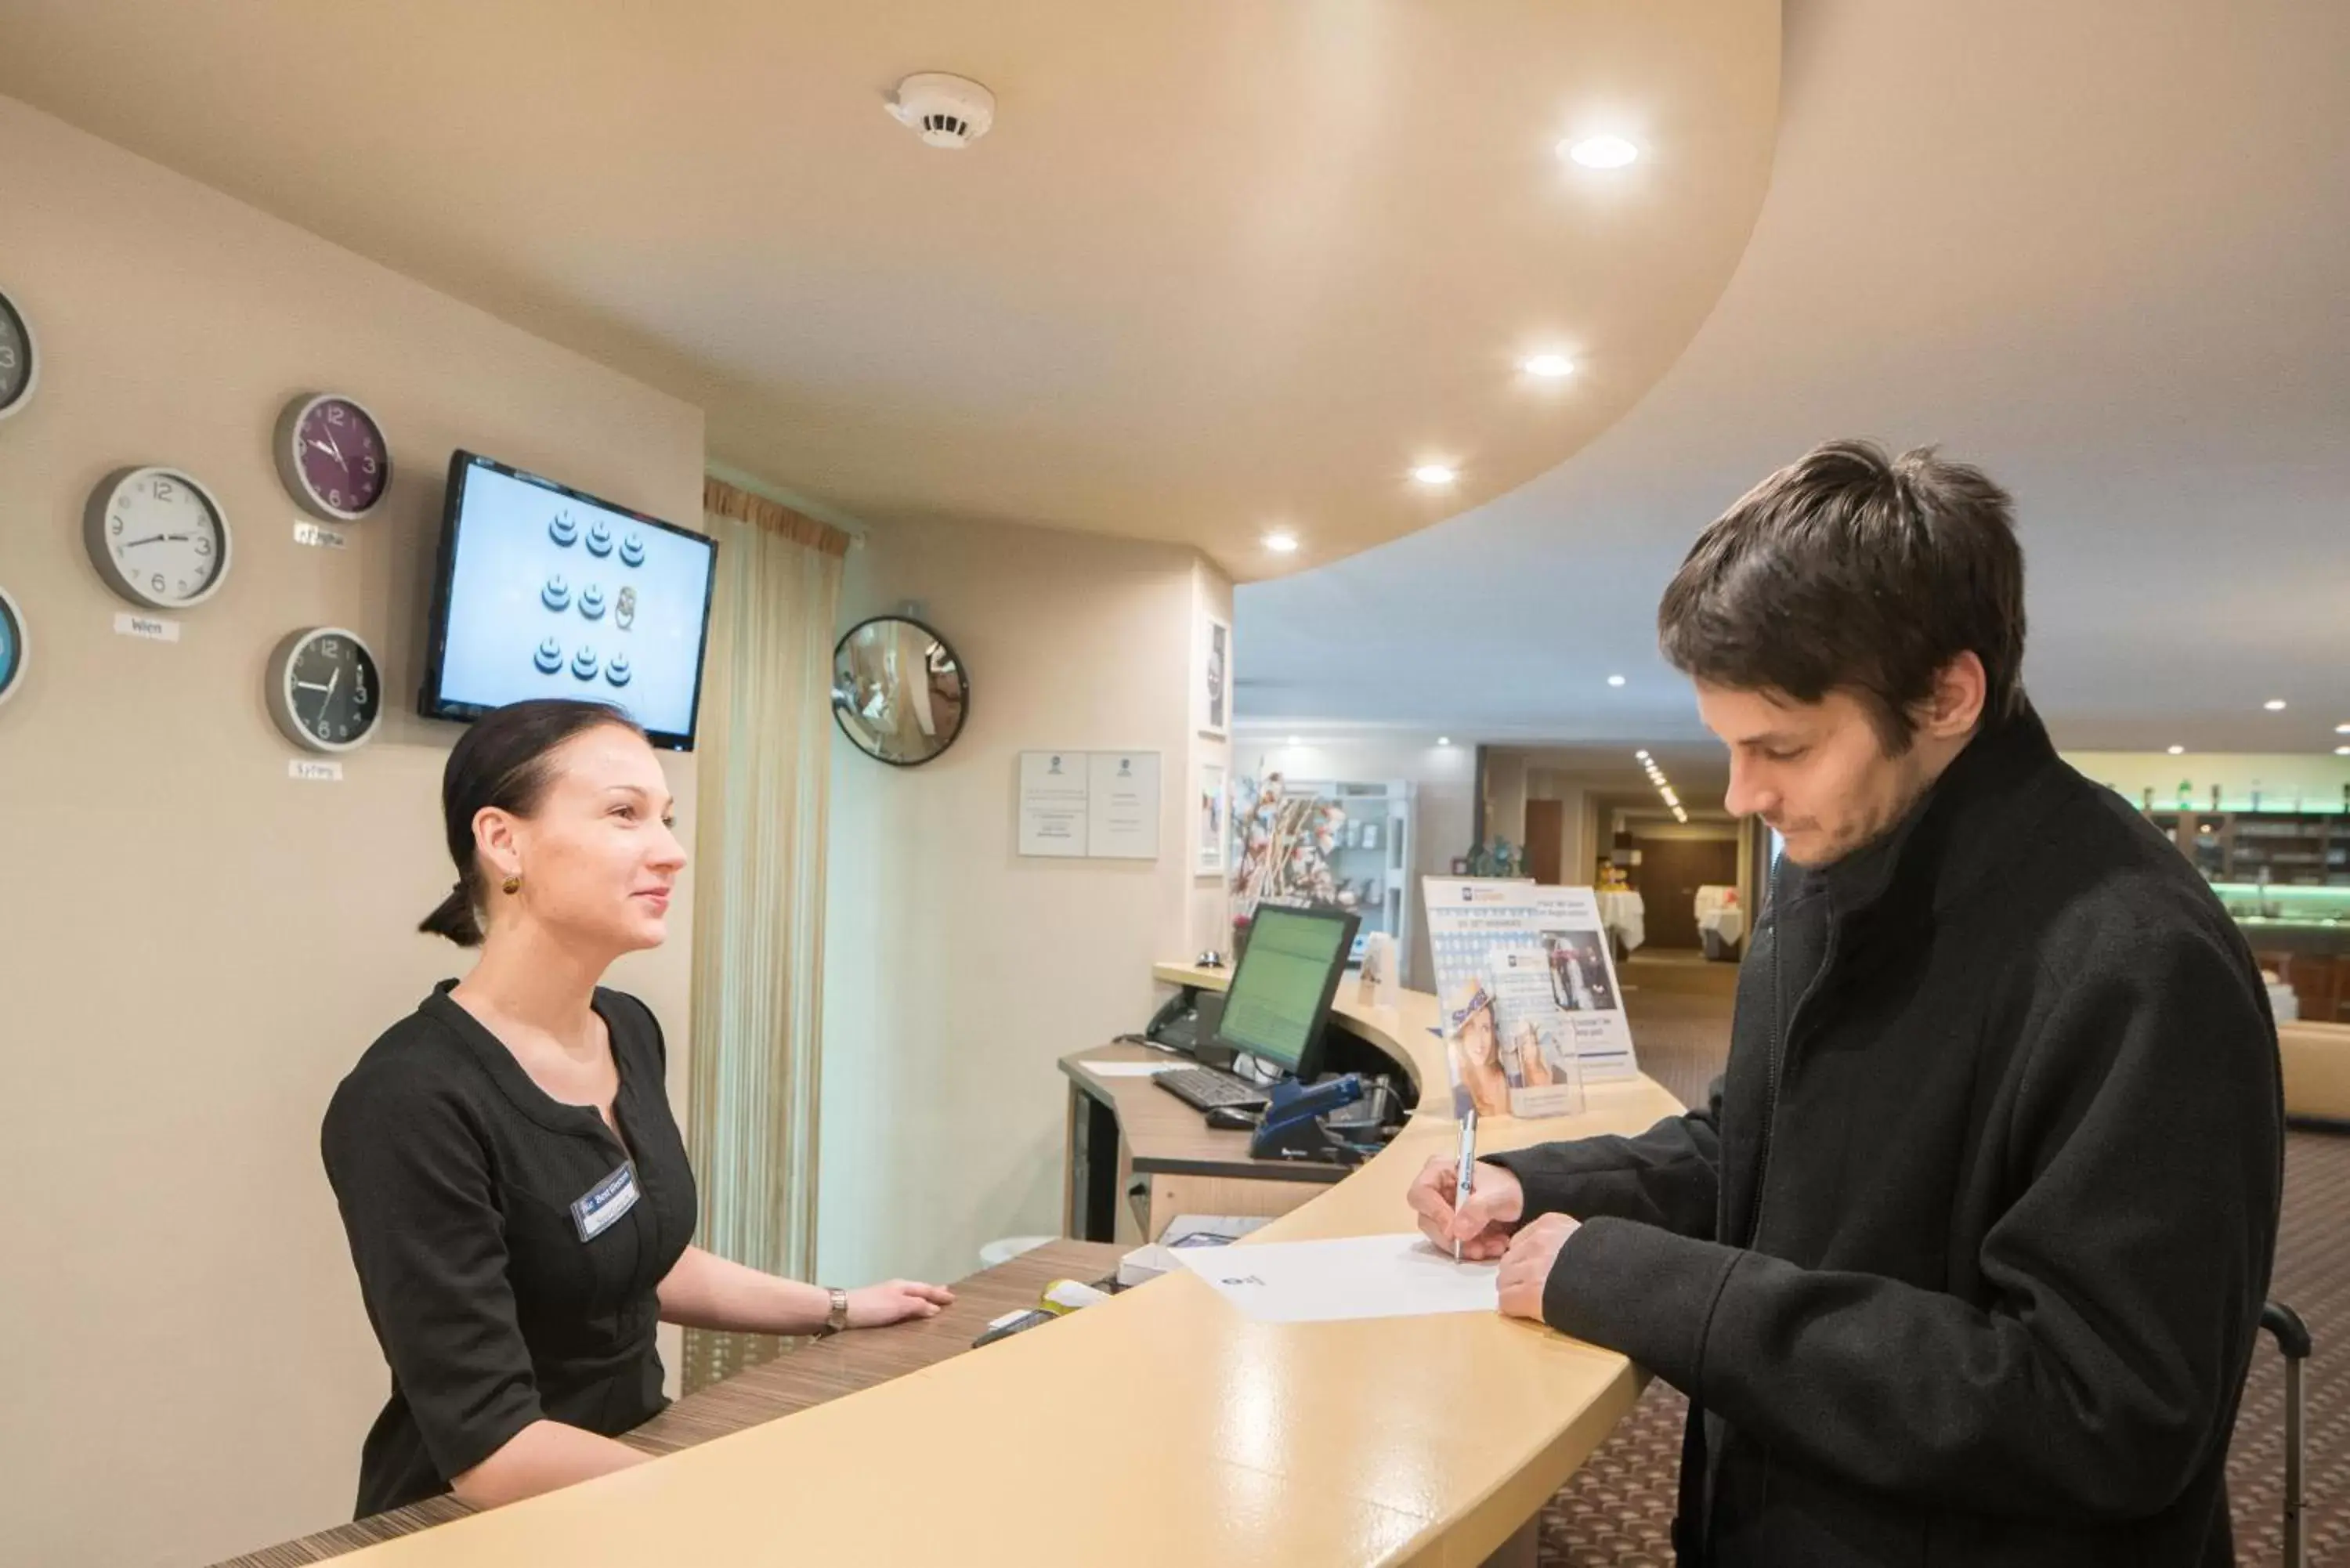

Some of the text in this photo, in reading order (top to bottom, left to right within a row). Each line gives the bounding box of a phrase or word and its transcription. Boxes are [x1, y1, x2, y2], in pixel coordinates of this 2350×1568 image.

[327, 404, 345, 427] 12
[362, 456, 375, 474] 3
[153, 481, 172, 503] 12
[329, 489, 341, 508] 6
[112, 515, 124, 536] 9
[194, 537, 211, 556] 3
[151, 573, 165, 594] 6
[321, 638, 339, 659] 12
[353, 685, 367, 704] 3
[317, 720, 331, 739] 6
